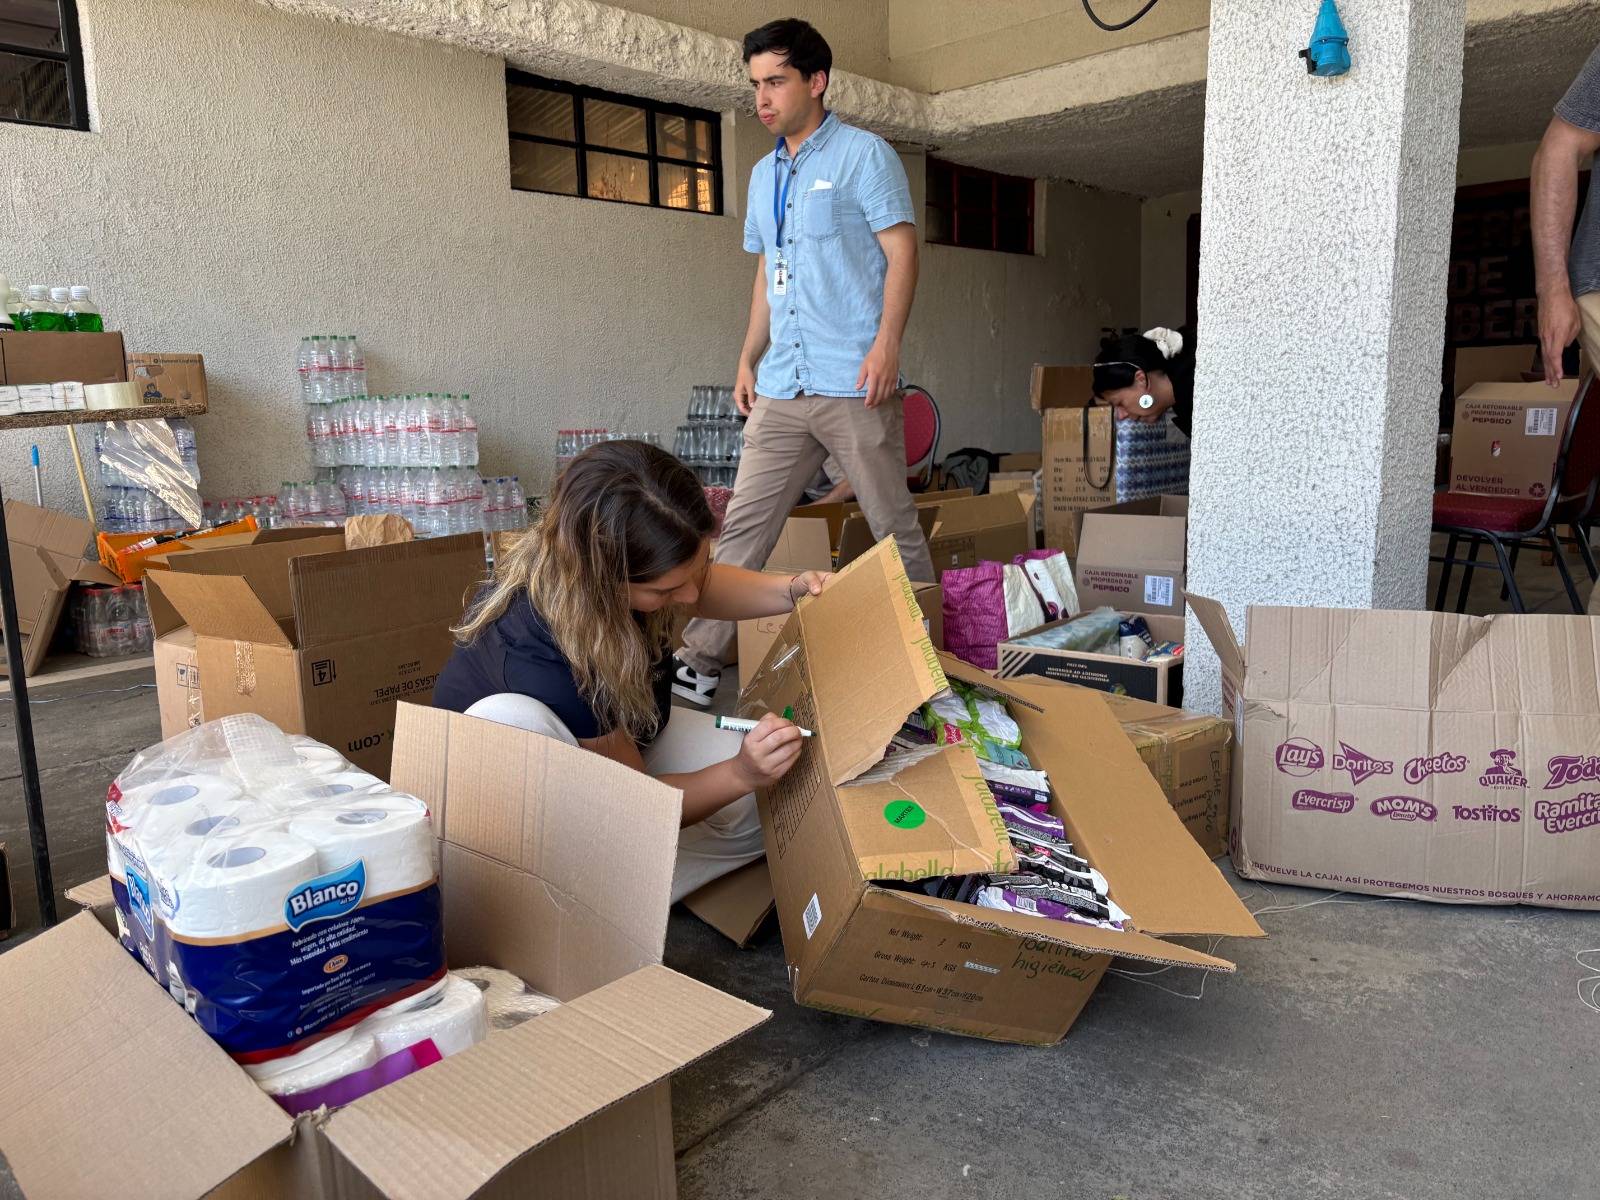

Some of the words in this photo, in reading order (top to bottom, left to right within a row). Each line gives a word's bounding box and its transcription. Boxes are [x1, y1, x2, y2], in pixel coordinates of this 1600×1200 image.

[1472, 417, 1512, 425] PEPSICO
[1456, 474, 1503, 483] DEVOLVER
[1470, 485, 1520, 496] VENDEDOR
[1100, 571, 1138, 579] RETORNABLE
[1092, 584, 1130, 593] PEPSICO
[373, 684, 400, 698] PAPEL
[401, 681, 413, 690] DE
[1278, 744, 1321, 768] Lay's
[1333, 754, 1393, 774] Doritos
[1404, 752, 1467, 784] Cheetos
[1479, 775, 1528, 788] QUAKER
[1297, 791, 1351, 812] Evercrisp
[1376, 798, 1433, 818] MOM'S
[1300, 870, 1312, 878] LA
[1315, 872, 1342, 882] CAJA!
[1345, 874, 1360, 884] ASÍ
[1363, 878, 1430, 892] PROTEGEMOS
[1432, 886, 1485, 897] NUESTROS
[1488, 890, 1534, 899] BOSQUES
[290, 881, 359, 917] Blanco
[859, 974, 880, 984] Carton
